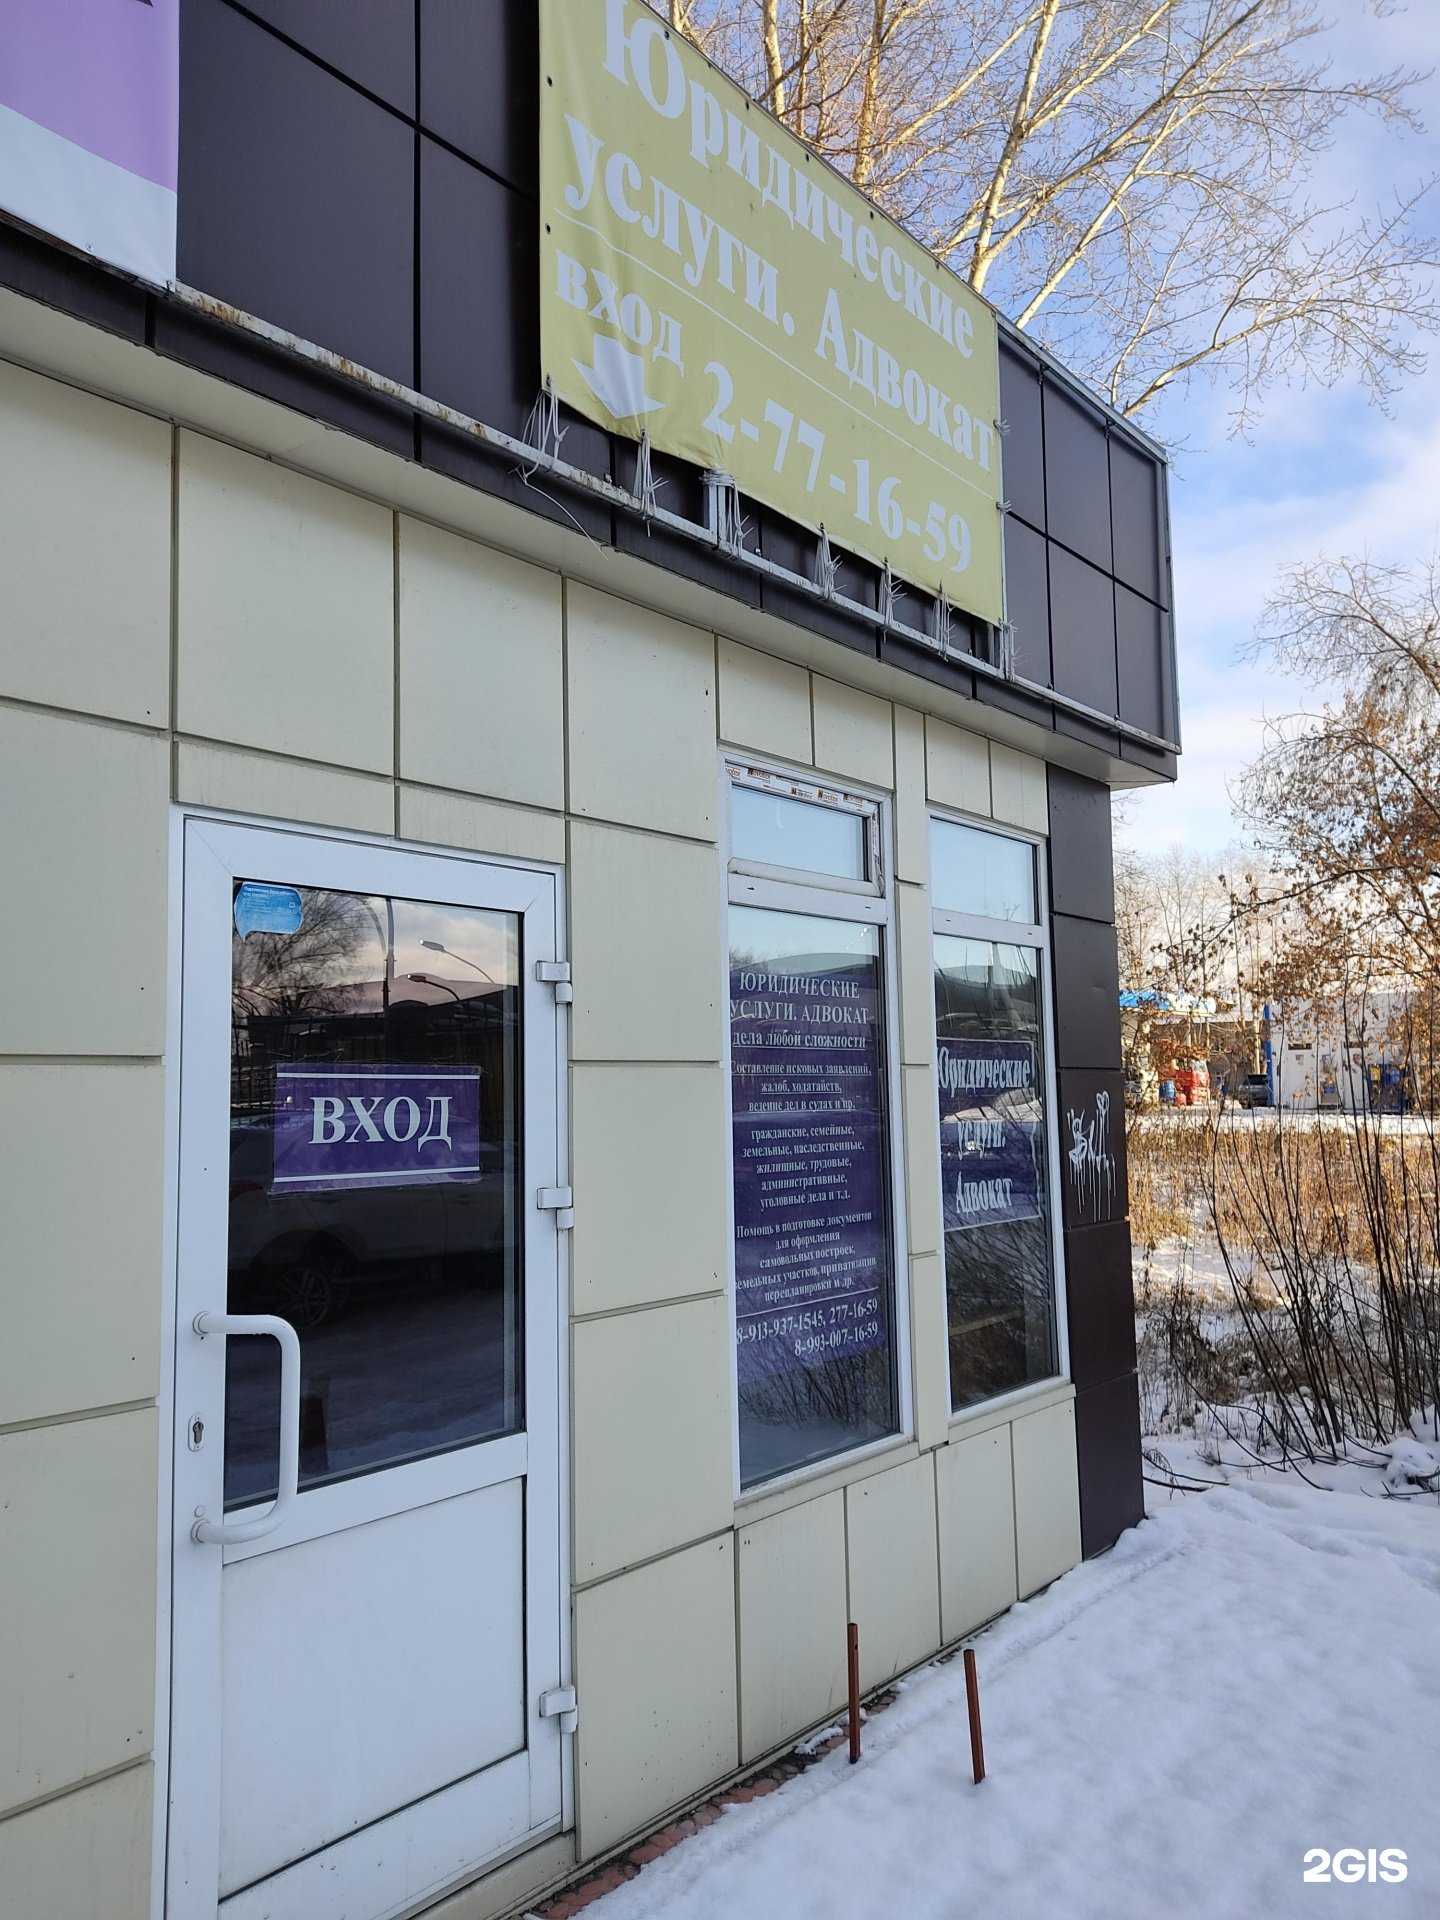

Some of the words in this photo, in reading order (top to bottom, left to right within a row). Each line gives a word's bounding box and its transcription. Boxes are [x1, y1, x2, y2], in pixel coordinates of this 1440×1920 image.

[602, 0, 975, 360] Юридические
[564, 113, 796, 337] услуги.
[815, 287, 995, 472] Адвокат
[555, 249, 685, 377] вход
[703, 360, 973, 574] 2-77-16-59
[740, 971, 860, 999] ЮРИДИЧЕСКИЕ
[730, 999, 798, 1021] УСЛУГИ.
[802, 1004, 869, 1025] АДВОКАТ
[732, 1031, 763, 1046] дела
[765, 1029, 801, 1047] любой
[804, 1035, 866, 1048] сложности
[308, 1096, 453, 1153] ВХОД
[748, 1101, 783, 1113] ведение
[784, 1101, 799, 1112] дел
[801, 1101, 806, 1110] в
[808, 1099, 834, 1113] судах
[956, 1171, 1013, 1217] Адвокат
[736, 1224, 775, 1239] Помощь
[829, 1297, 878, 1324] 277-16-59
[794, 1320, 878, 1357] 8-993-007-16-59
